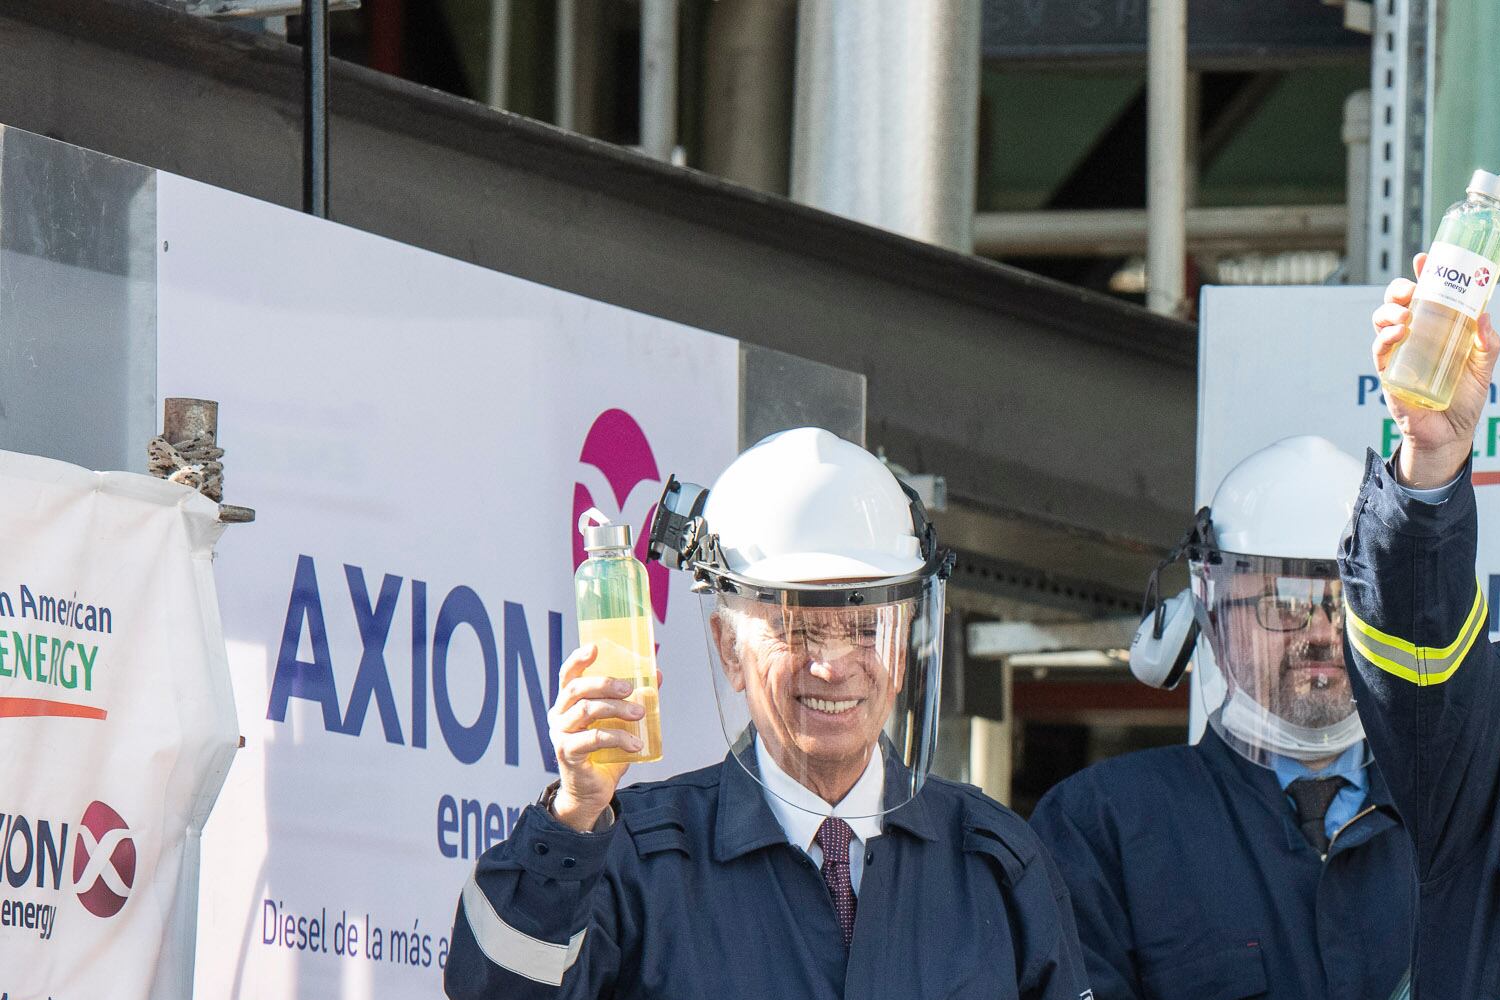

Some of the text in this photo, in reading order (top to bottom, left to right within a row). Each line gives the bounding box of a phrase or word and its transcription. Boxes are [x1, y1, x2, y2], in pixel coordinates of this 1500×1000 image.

[1434, 265, 1471, 287] XION
[1444, 281, 1467, 294] energy
[20, 585, 112, 633] American
[0, 630, 98, 691] ENERGY
[266, 553, 563, 773] AXION
[2, 900, 57, 940] energy
[263, 899, 327, 953] Diesel
[334, 910, 358, 957] de
[366, 914, 383, 961] la
[390, 918, 432, 968] más
